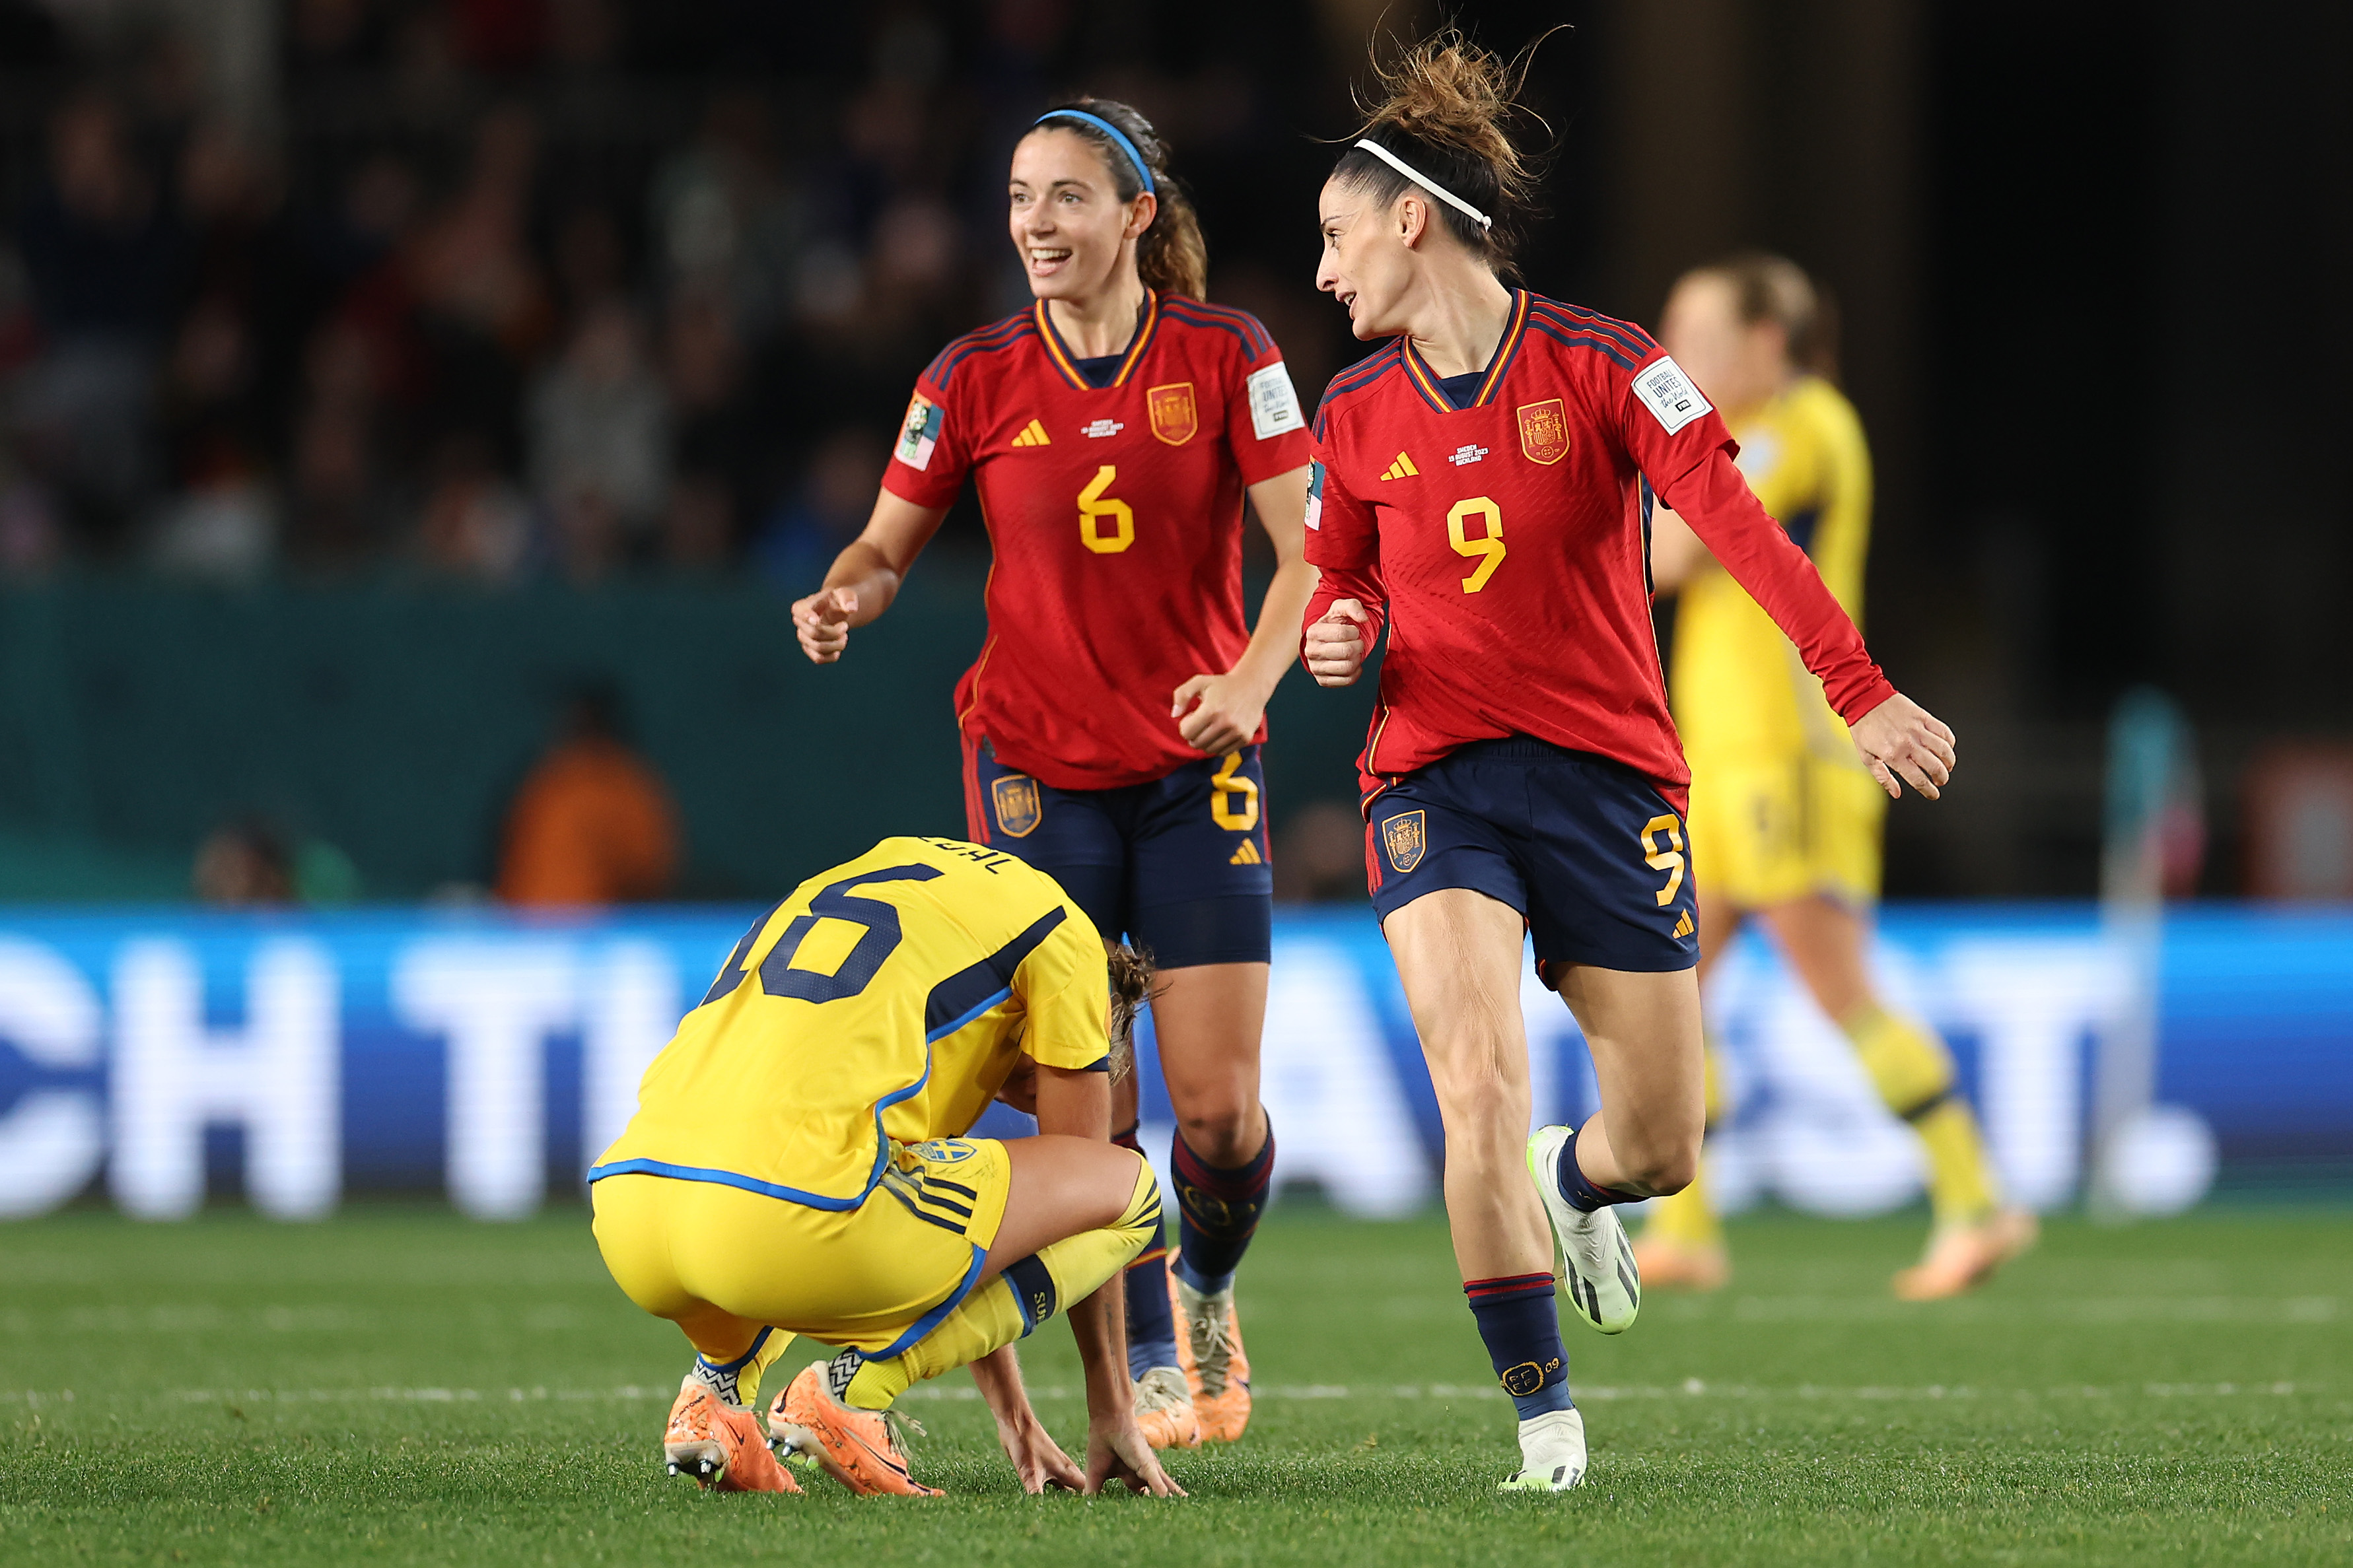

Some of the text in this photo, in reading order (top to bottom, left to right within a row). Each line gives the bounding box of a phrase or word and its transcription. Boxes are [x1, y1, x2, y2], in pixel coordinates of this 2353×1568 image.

[1647, 369, 1674, 389] FOOTBALL
[1653, 377, 1681, 397] UNITES
[1660, 397, 1673, 408] the
[1457, 444, 1477, 454] SWEDEN
[1456, 455, 1481, 466] AUCKLAND
[1077, 464, 1135, 554] 6
[1447, 496, 1506, 594] 9
[1211, 751, 1259, 831] 6
[1641, 814, 1685, 907] 9
[700, 862, 945, 1004] 16
[1545, 1357, 1559, 1373] 09
